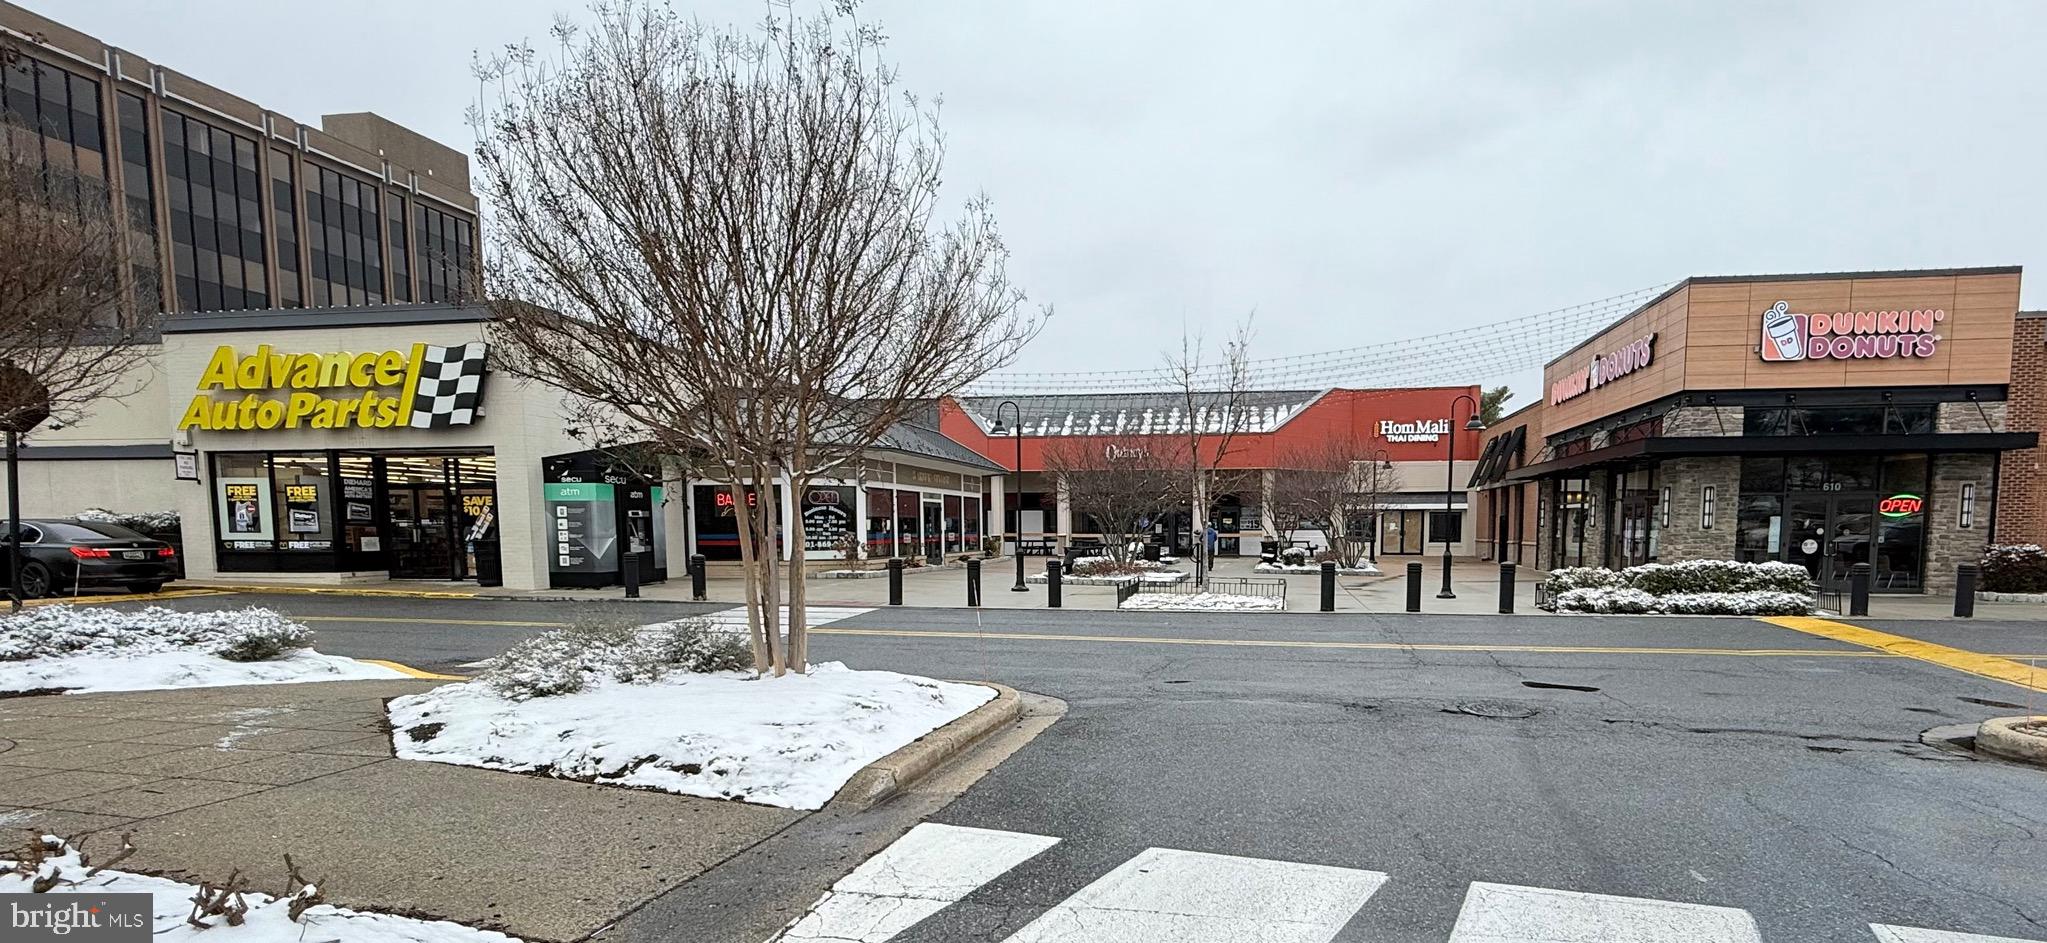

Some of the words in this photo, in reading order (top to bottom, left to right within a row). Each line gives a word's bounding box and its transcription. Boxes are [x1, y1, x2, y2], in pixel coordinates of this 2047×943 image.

[1810, 310, 1945, 336] DUNKIN'
[1808, 333, 1943, 359] DONUTS
[1599, 333, 1655, 385] DONUTS
[197, 344, 407, 391] Advance
[177, 394, 287, 431] Auto
[285, 390, 400, 430] Parts
[1380, 420, 1415, 435] Hom
[1415, 418, 1449, 434] Mali
[1386, 434, 1407, 442] THAI
[1408, 433, 1439, 442] DINING
[604, 474, 627, 485] secu
[226, 485, 257, 496] FREE
[286, 486, 317, 497] FREE
[560, 487, 580, 496] atm
[1822, 482, 1842, 491] 610
[462, 495, 493, 506] SAVE
[629, 491, 644, 499] atm
[1879, 499, 1923, 512] OPEN
[234, 541, 256, 549] FREE
[288, 541, 311, 549] FREE
